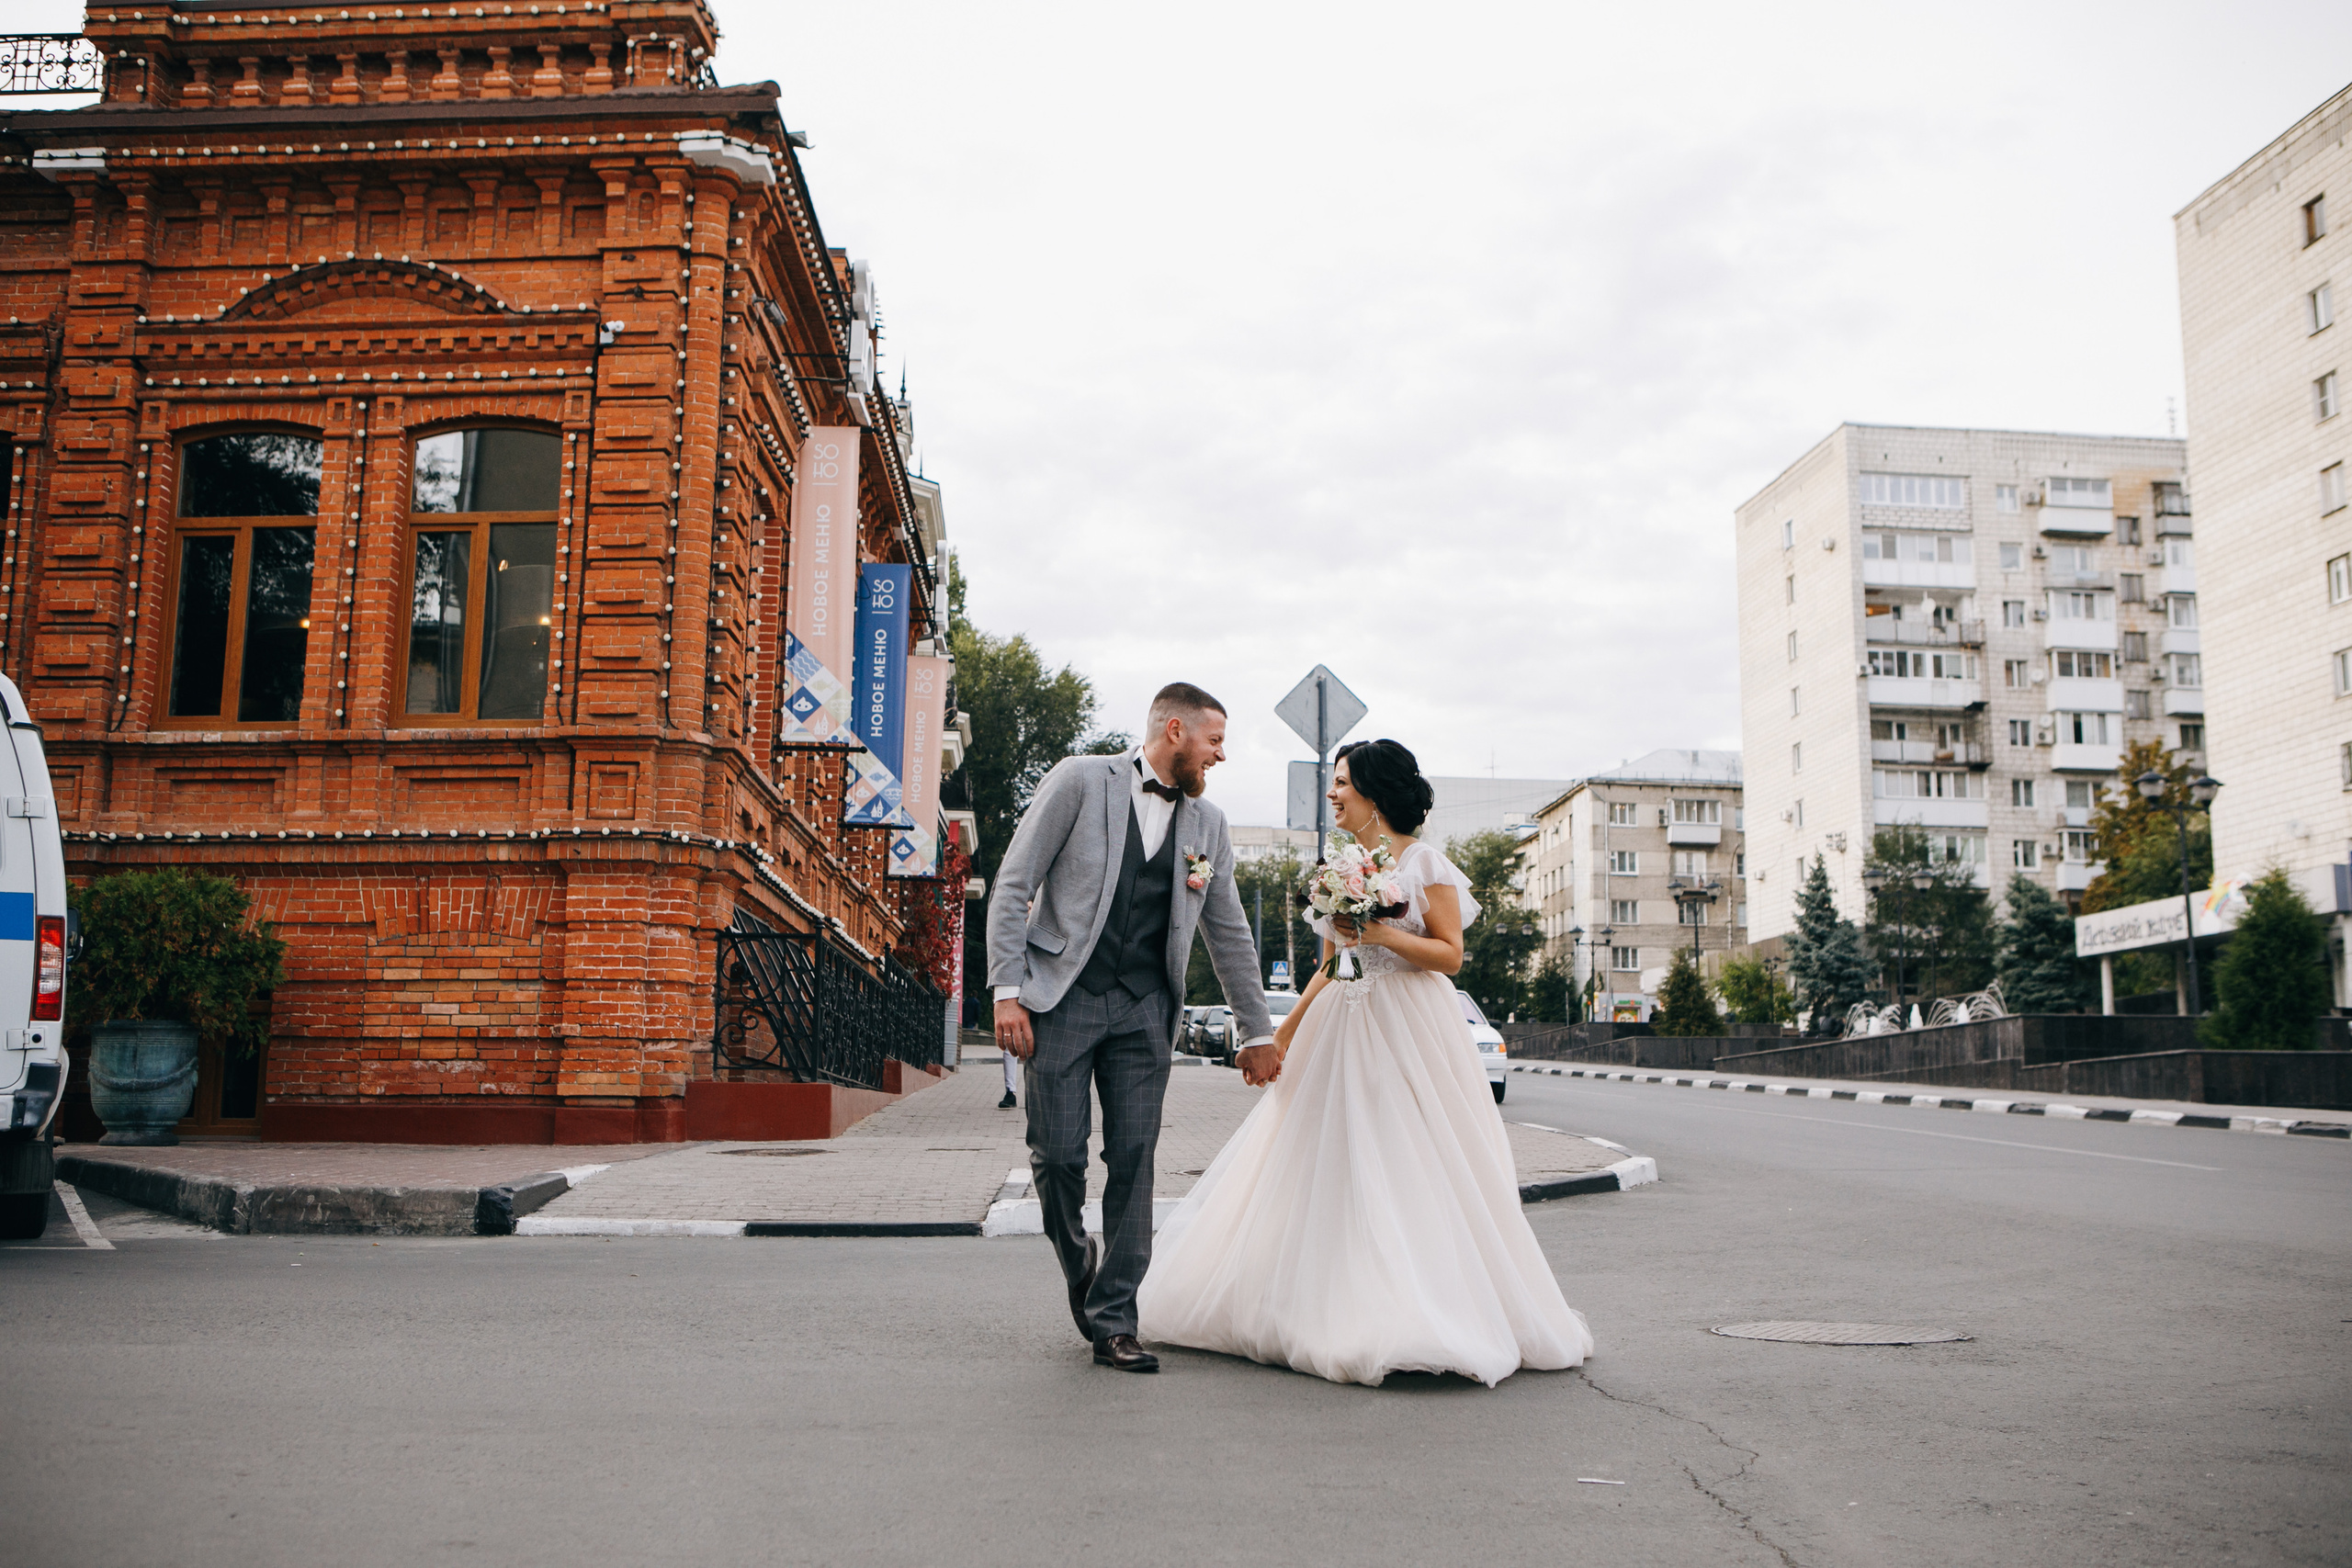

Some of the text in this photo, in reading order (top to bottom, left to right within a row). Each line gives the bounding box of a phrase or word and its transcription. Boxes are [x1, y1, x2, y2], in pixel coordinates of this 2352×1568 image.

[813, 444, 840, 459] SO
[812, 462, 839, 479] HO
[812, 504, 831, 637] НОВОЕ МЕНЮ
[873, 579, 895, 592] SO
[872, 594, 894, 608] HO
[870, 628, 888, 737] НОВОЕ МЕНЮ
[910, 711, 926, 803] НОВОЕ МЕНЮ
